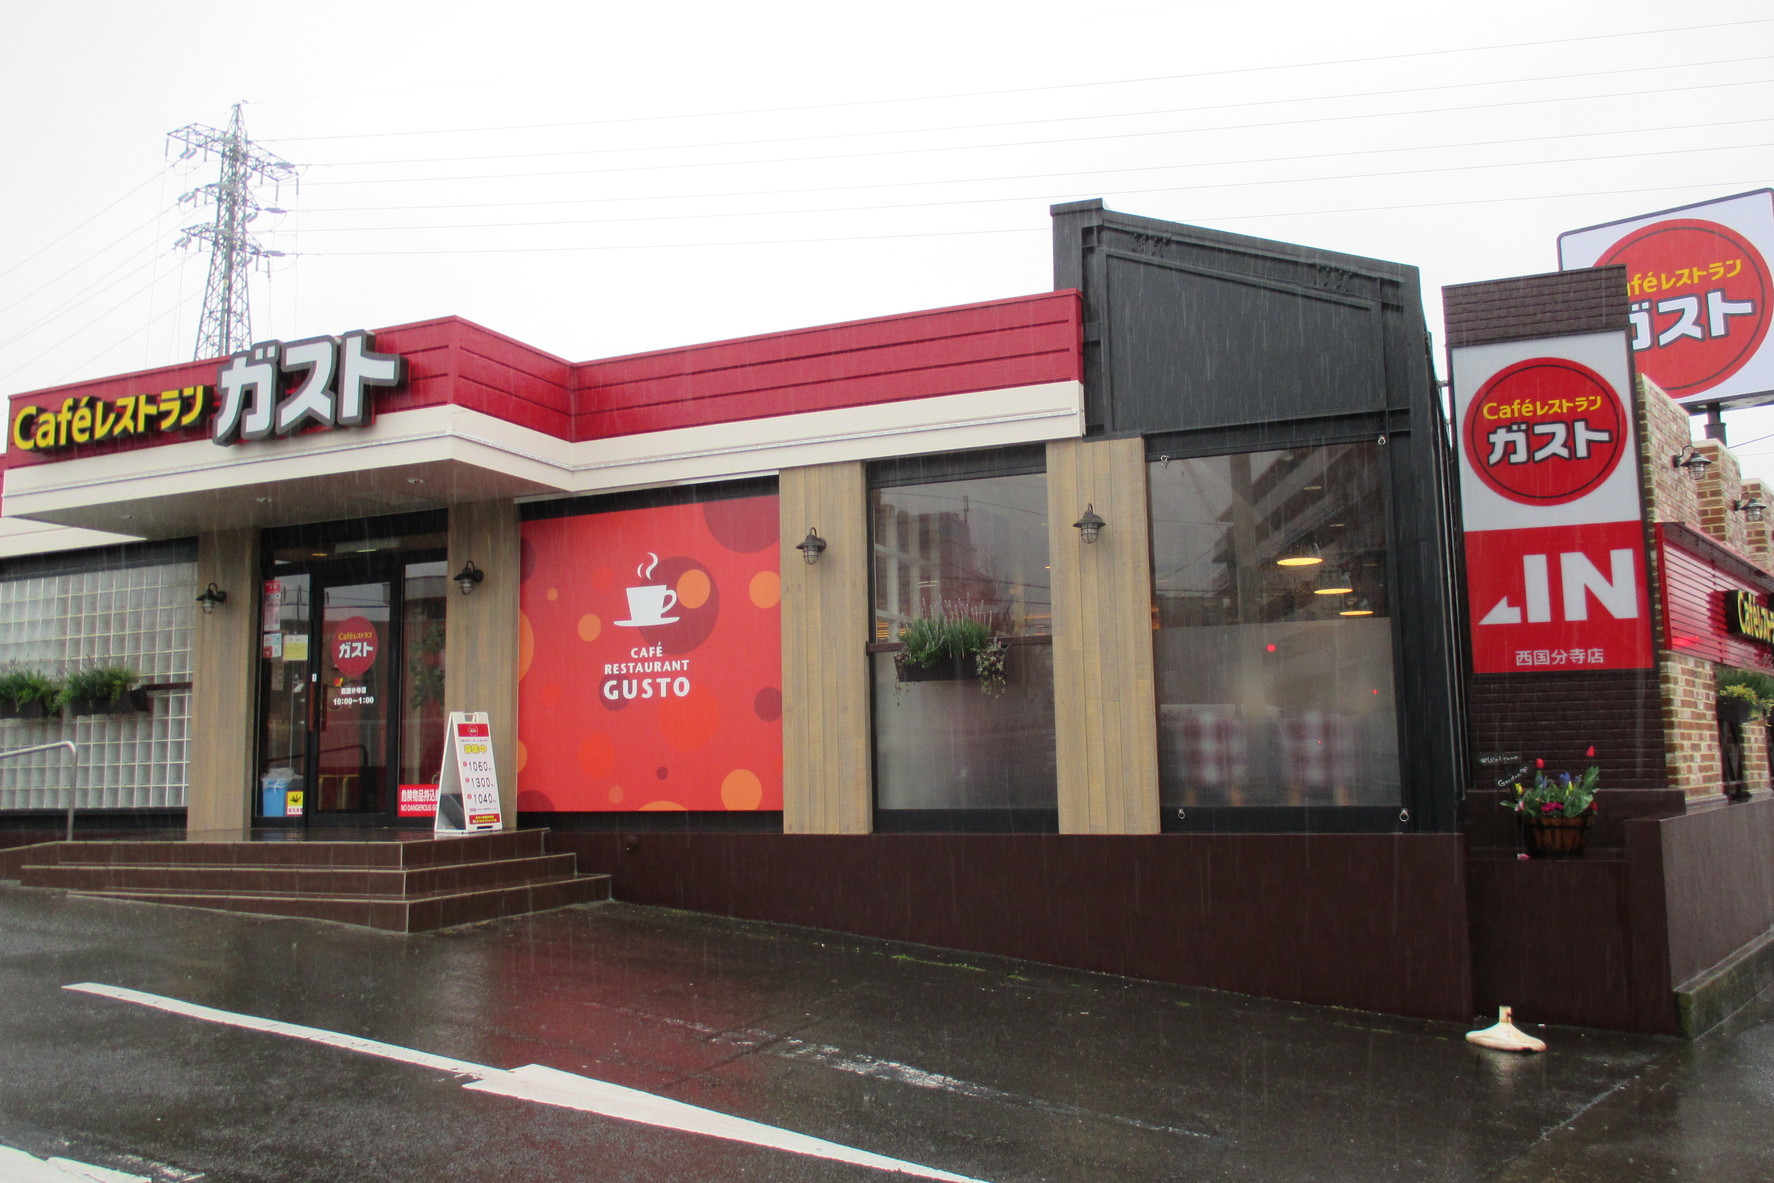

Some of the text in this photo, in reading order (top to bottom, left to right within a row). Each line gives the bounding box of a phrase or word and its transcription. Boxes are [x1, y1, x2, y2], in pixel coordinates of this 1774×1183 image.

[215, 333, 399, 443] ガスト
[1483, 396, 1602, 420] Caféレストラン
[1487, 419, 1612, 465] ガスト
[1523, 549, 1638, 623] IN
[338, 642, 374, 659] ガスト
[630, 641, 663, 659] CAFÉ
[1515, 648, 1604, 666] 西国分寺店
[604, 659, 690, 675] RESTAURANT
[603, 676, 691, 701] GUSTO
[471, 777, 491, 788] 1300
[473, 793, 493, 804] 1040
